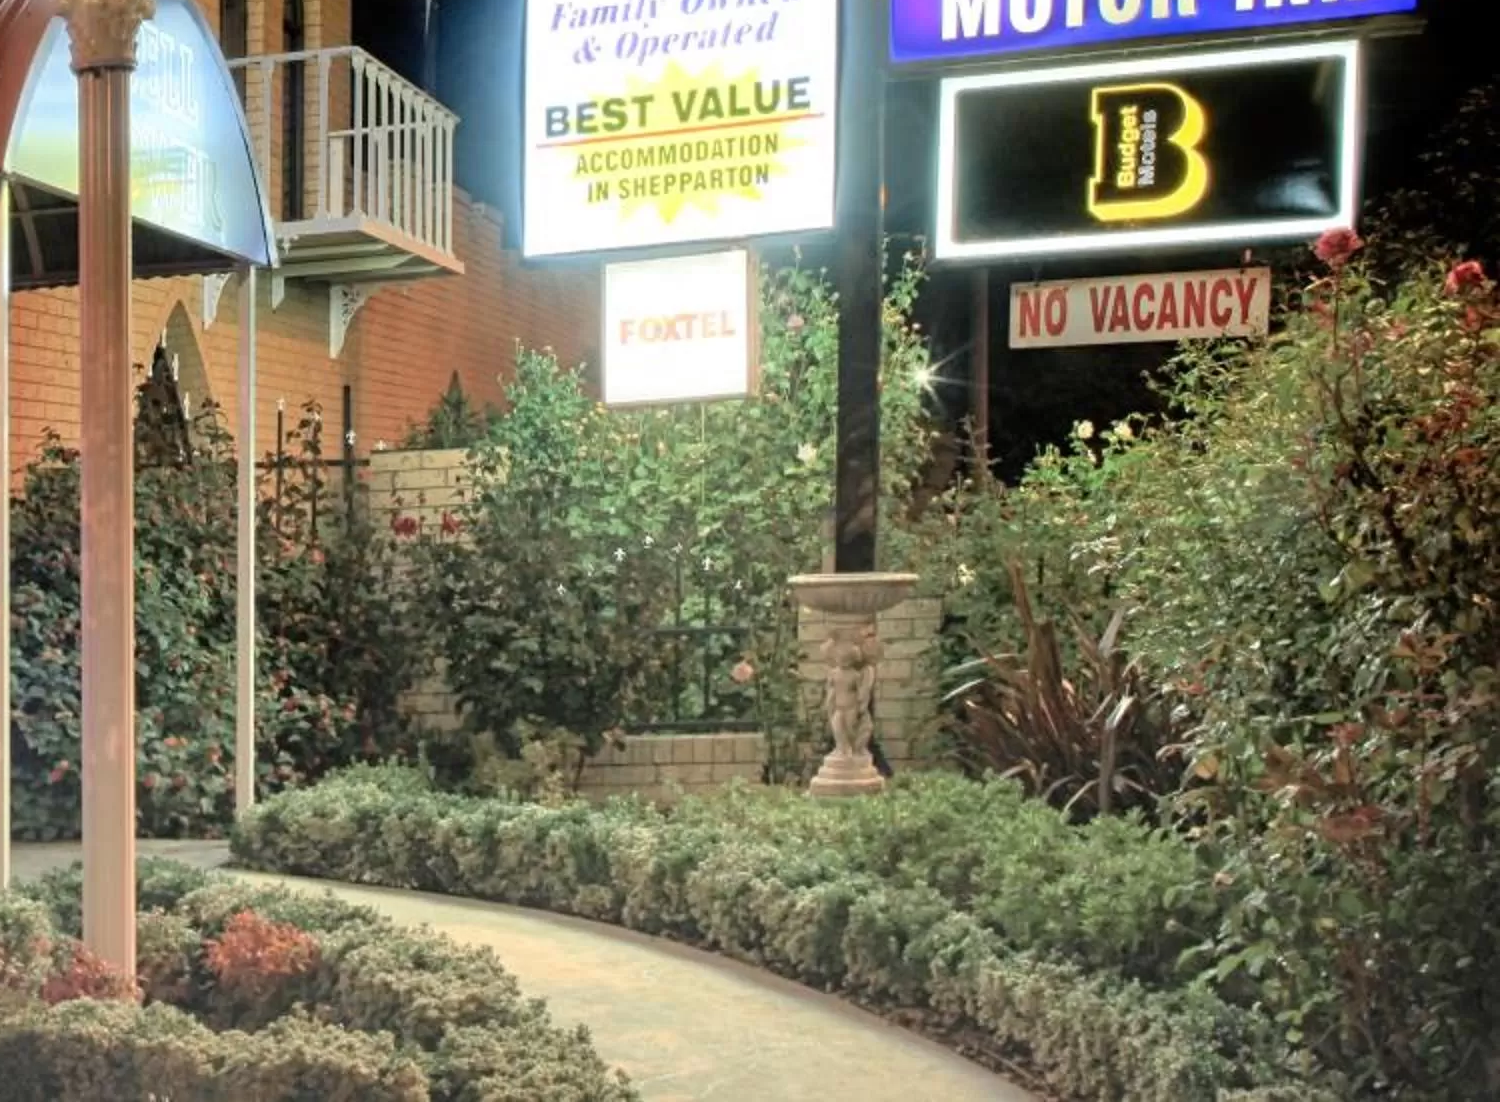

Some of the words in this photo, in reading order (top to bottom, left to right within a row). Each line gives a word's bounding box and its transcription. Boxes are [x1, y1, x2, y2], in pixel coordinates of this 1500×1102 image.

[572, 35, 601, 65] &
[615, 11, 780, 66] Operated
[544, 95, 655, 139] BEST
[671, 76, 812, 124] VALUE
[575, 133, 780, 176] ACCOMMODATION
[1116, 105, 1140, 188] Budget
[1137, 109, 1158, 186] Motels
[587, 181, 610, 203] IN
[618, 163, 770, 200] SHEPPARTON
[619, 309, 737, 345] FOXTEL
[1017, 287, 1068, 339] NO
[1089, 277, 1258, 334] VACANCY
